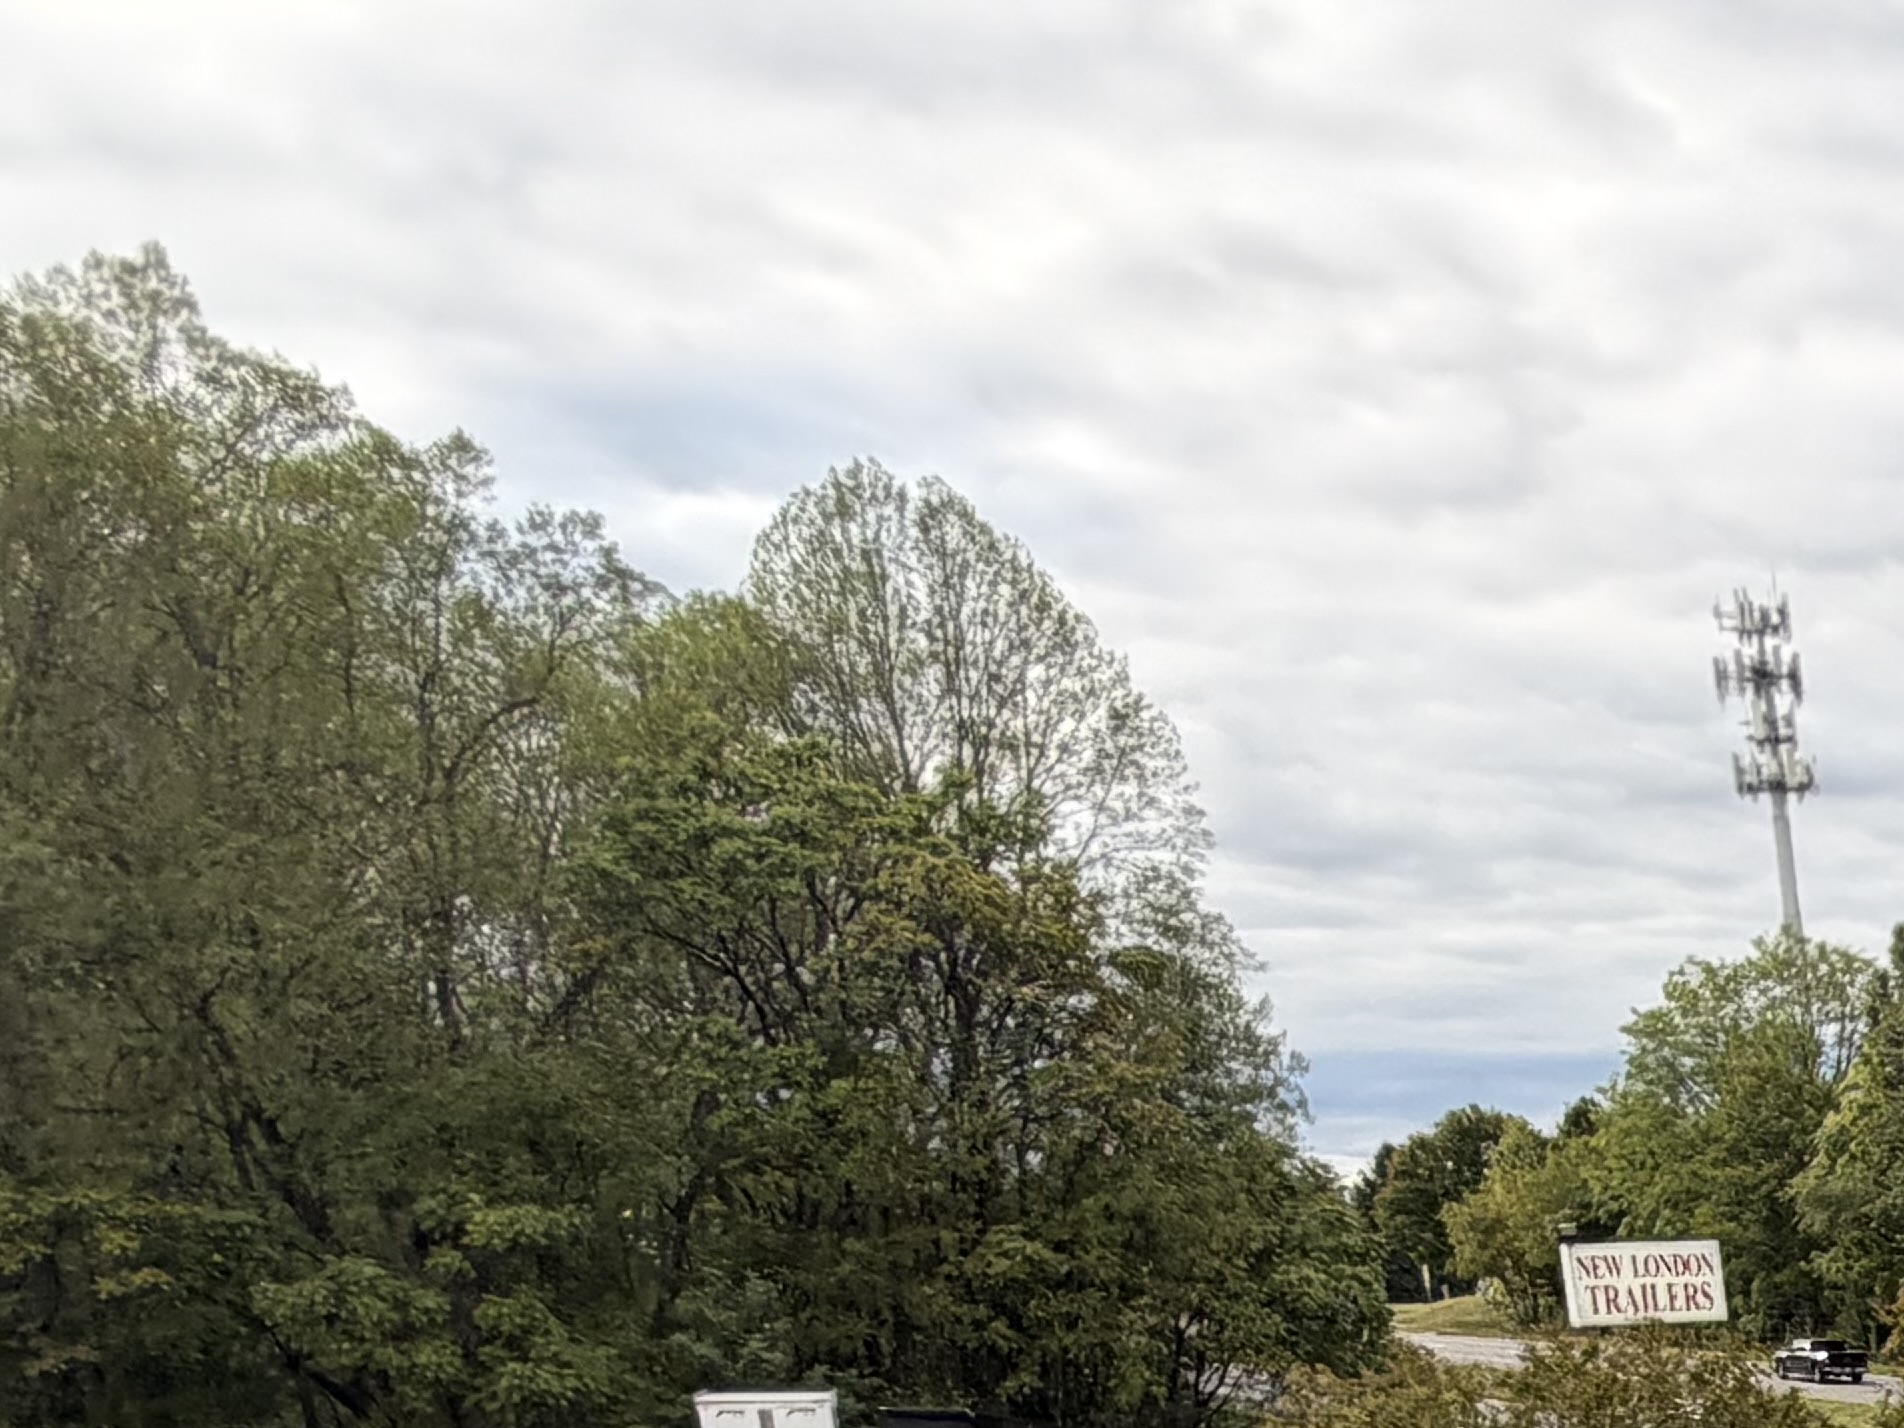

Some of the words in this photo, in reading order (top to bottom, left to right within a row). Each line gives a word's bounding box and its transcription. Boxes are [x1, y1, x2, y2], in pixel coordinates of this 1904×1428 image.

[1574, 1254, 1623, 1280] NEW
[1631, 1252, 1716, 1279] LONDON
[1584, 1280, 1715, 1316] TRAILERS
